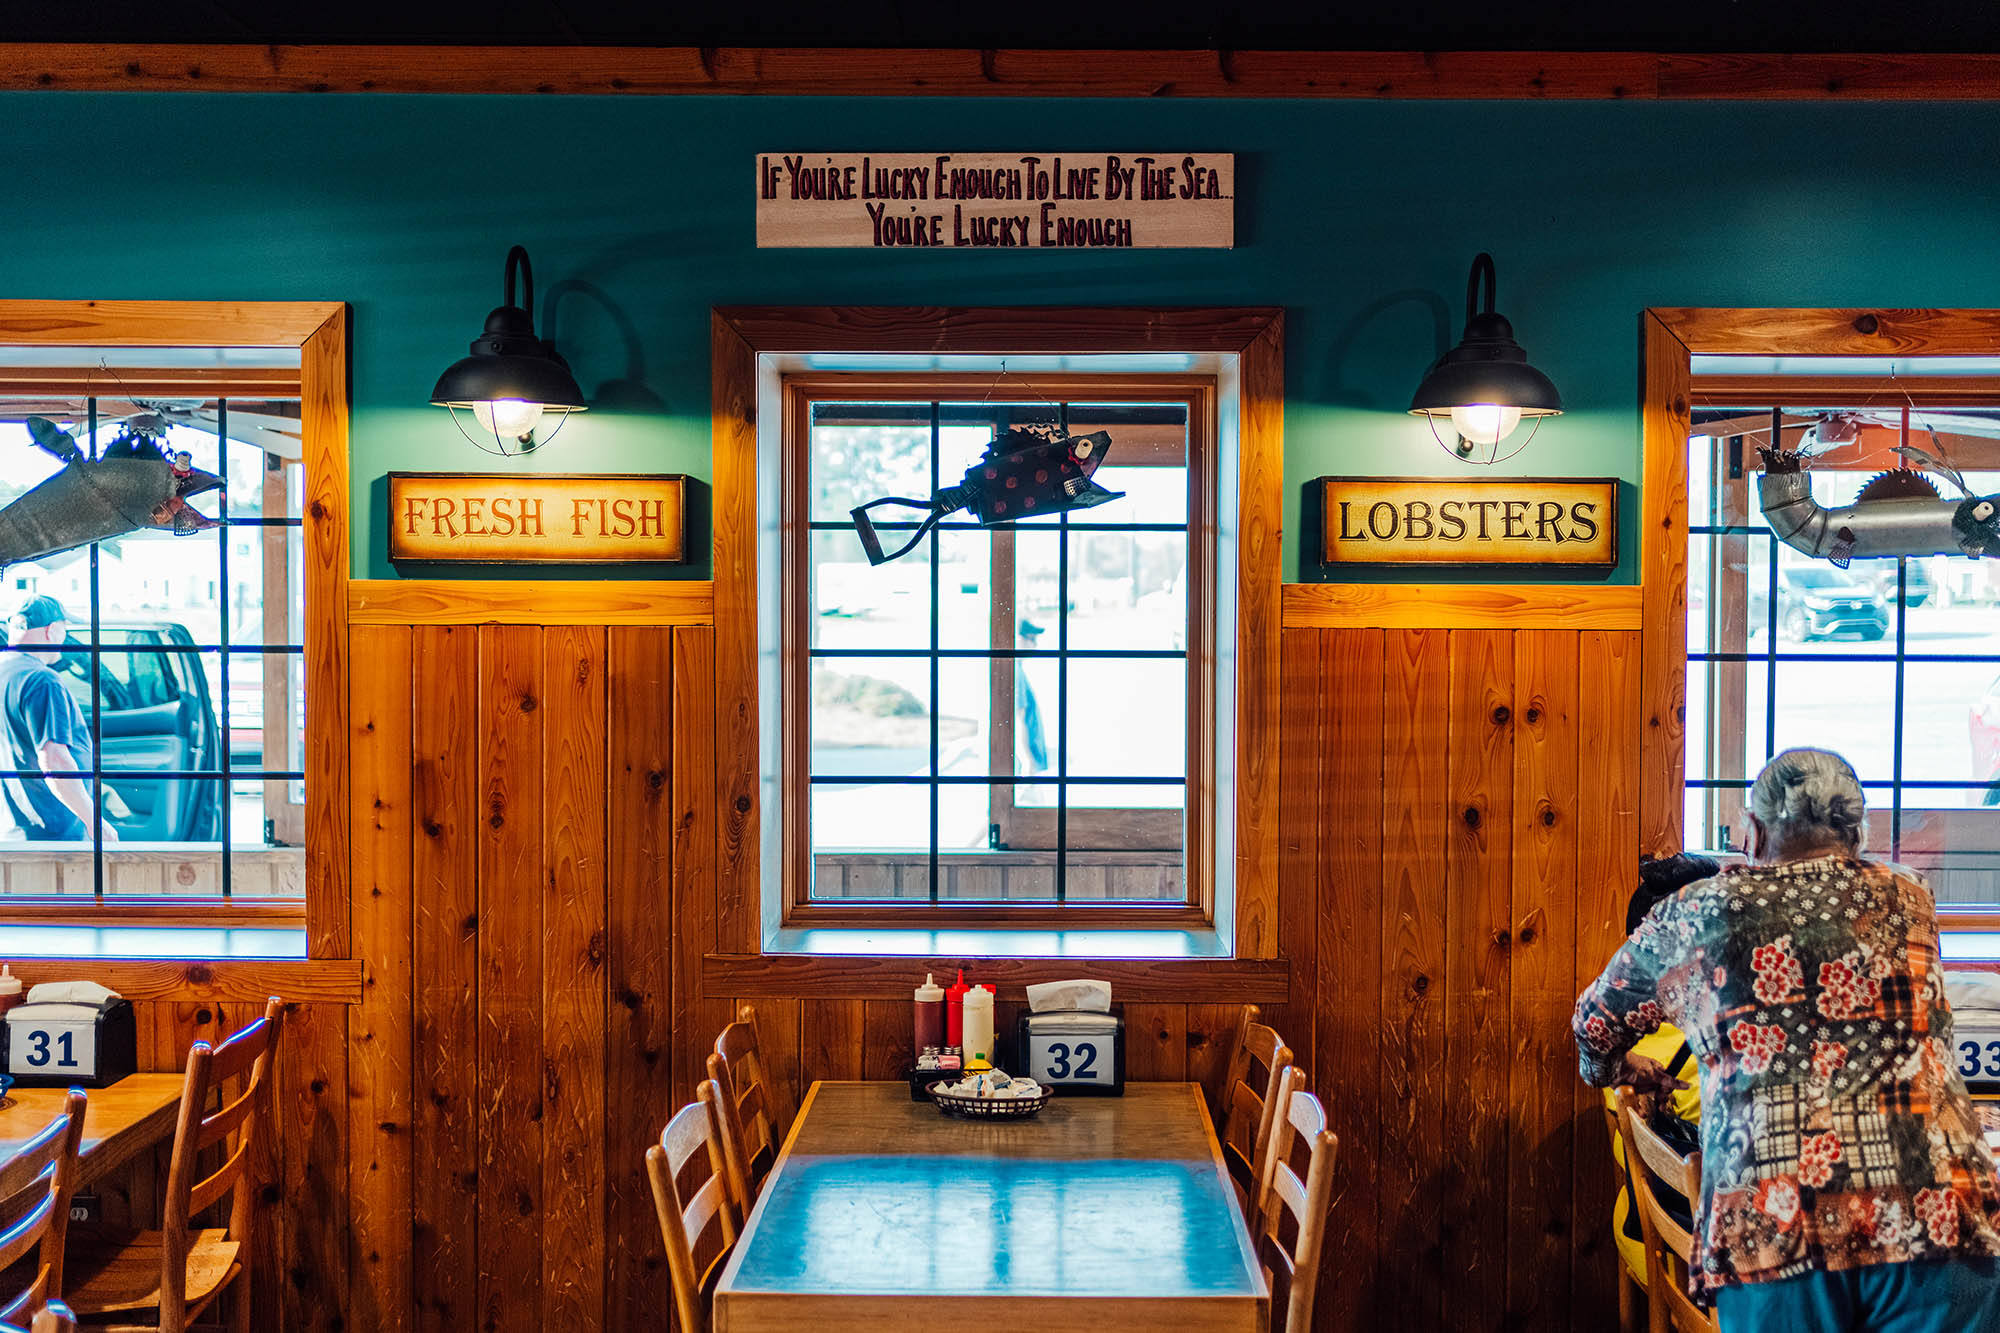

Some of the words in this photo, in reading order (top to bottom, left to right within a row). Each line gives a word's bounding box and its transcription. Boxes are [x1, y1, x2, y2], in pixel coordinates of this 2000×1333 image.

[762, 157, 782, 200] IF
[784, 155, 857, 200] YOU'RE
[862, 157, 930, 200] LUCKY
[935, 156, 1021, 200] ENOUGH
[1020, 157, 1049, 200] TO
[1053, 158, 1100, 200] LIVE
[1105, 156, 1135, 200] BY
[1134, 157, 1176, 200] THE
[865, 202, 944, 246] YOU'RE
[954, 204, 1030, 246] LUCKY
[1040, 202, 1132, 246] ENOUGH
[402, 497, 547, 538] FRESH
[571, 498, 666, 538] FISH
[1337, 501, 1599, 543] LOBSTERS
[26, 1031, 78, 1067] 31
[1046, 1042, 1097, 1079] 32
[1958, 1041, 2000, 1077] 33
